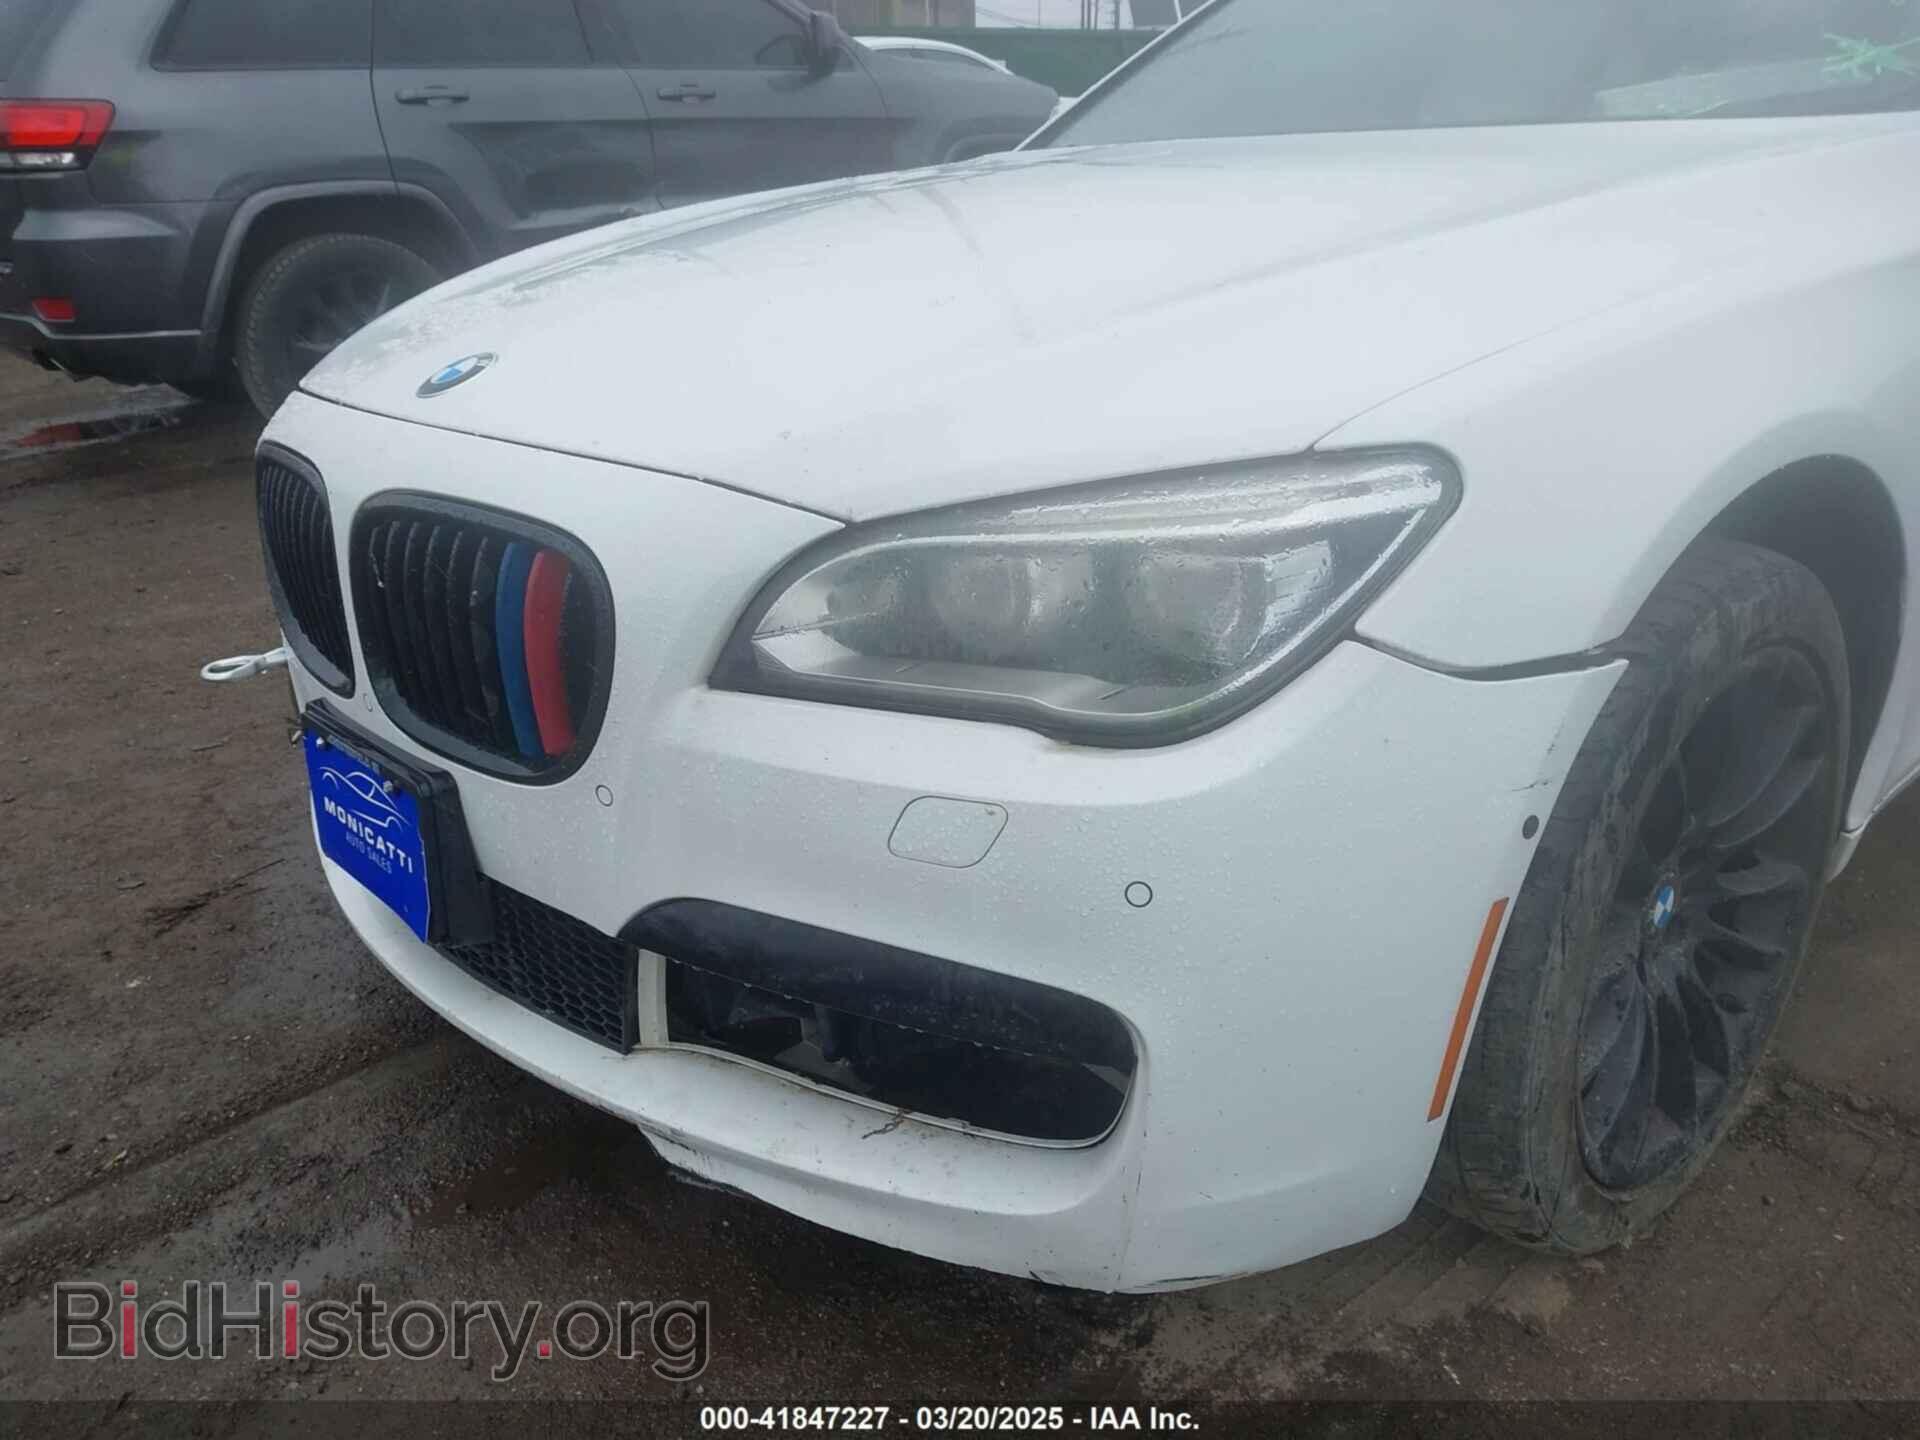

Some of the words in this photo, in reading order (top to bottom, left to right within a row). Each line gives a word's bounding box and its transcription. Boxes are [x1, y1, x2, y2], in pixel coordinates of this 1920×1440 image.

[323, 796, 413, 874] MONICATTI
[346, 831, 366, 854] AUTO
[367, 846, 393, 875] SALES
